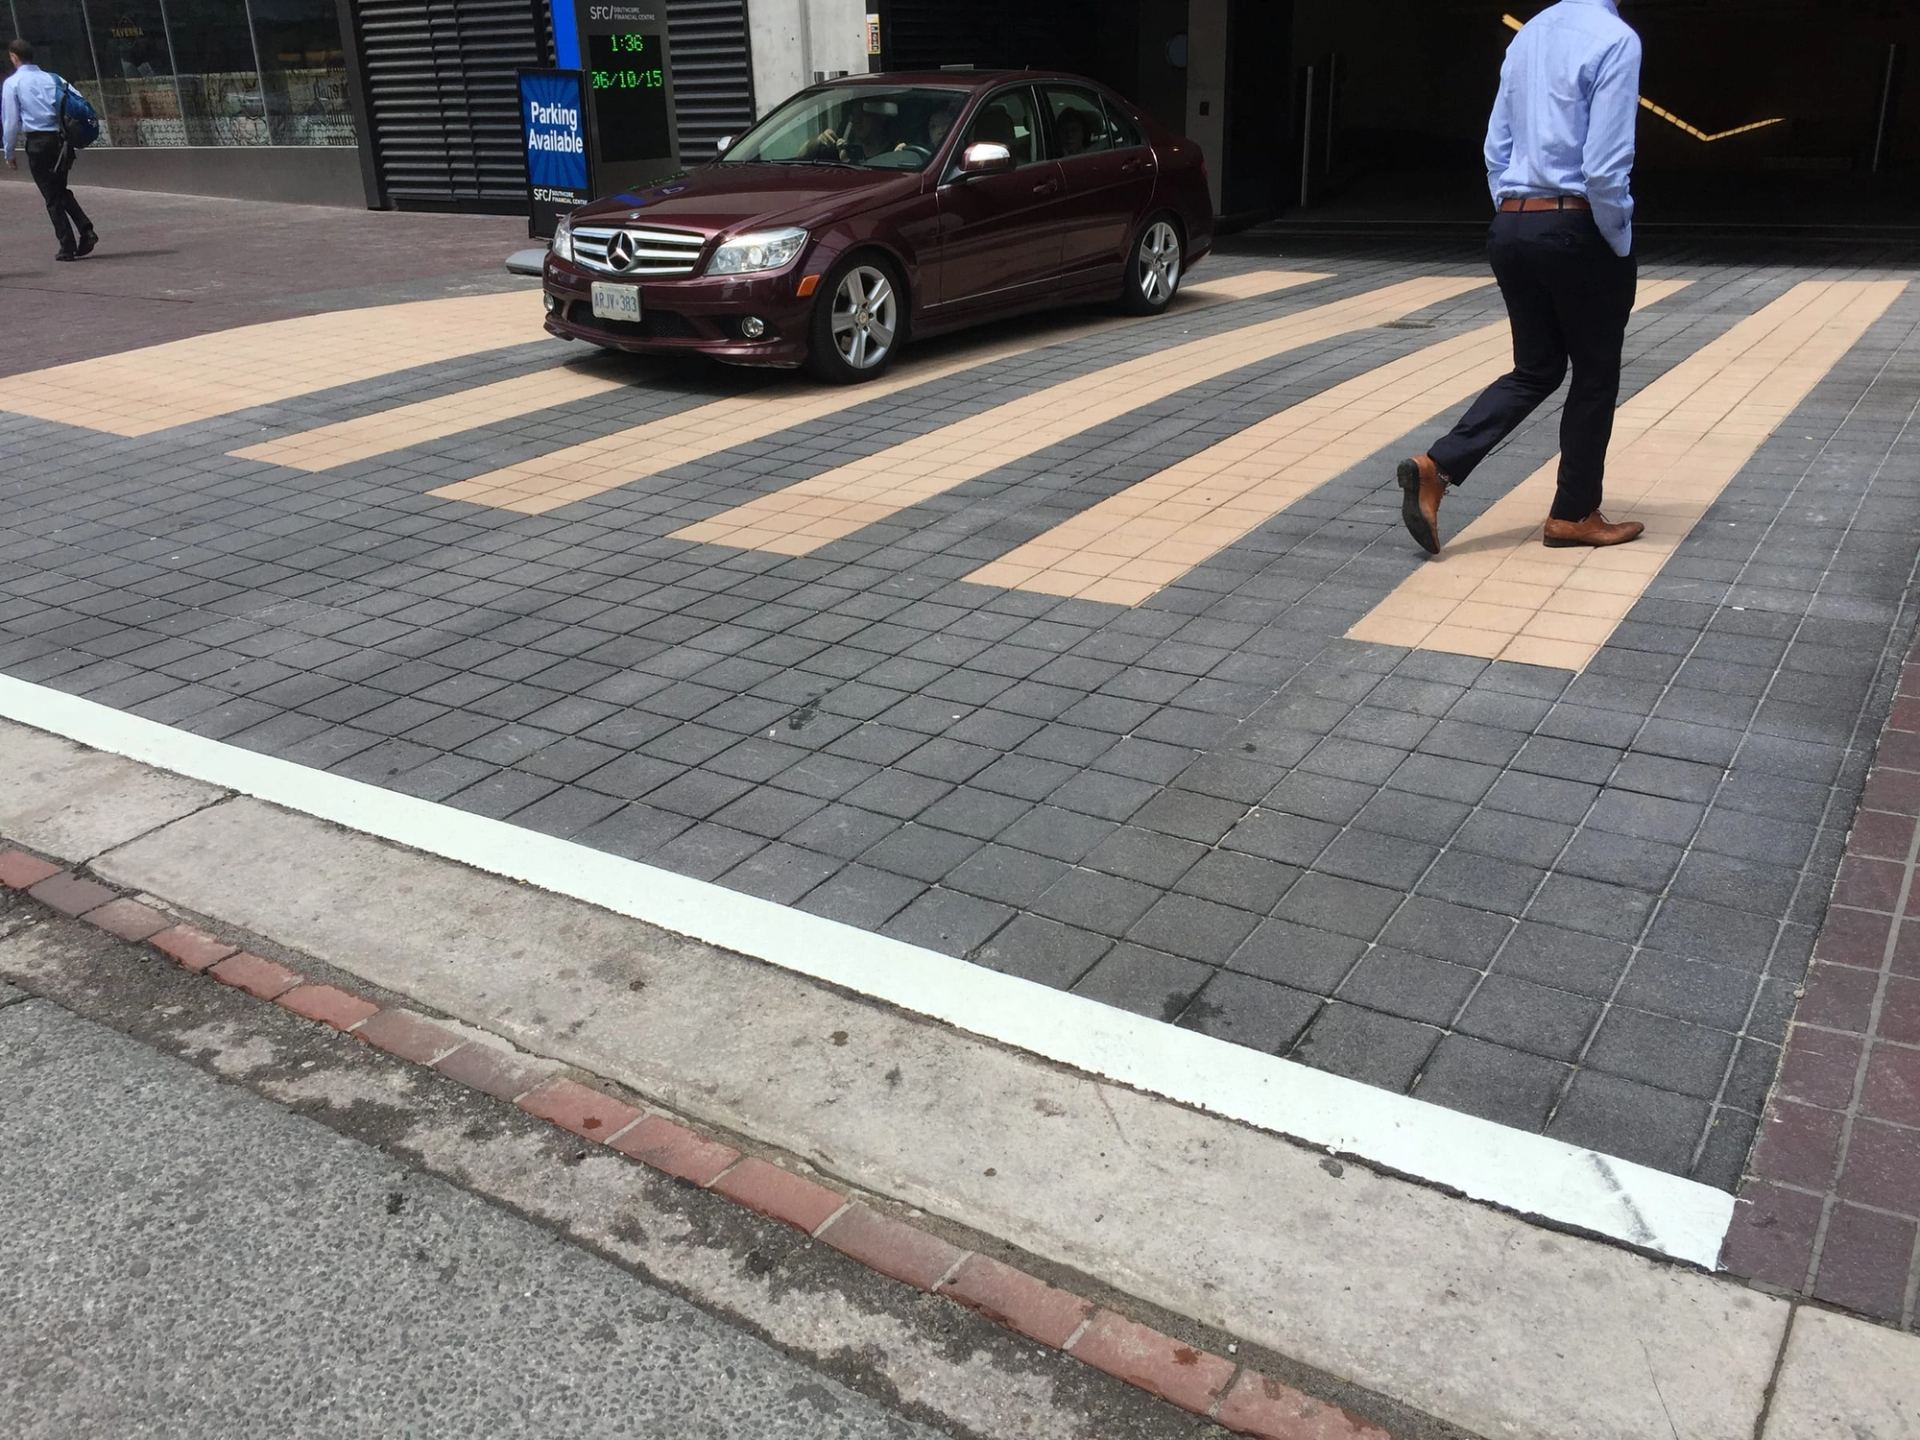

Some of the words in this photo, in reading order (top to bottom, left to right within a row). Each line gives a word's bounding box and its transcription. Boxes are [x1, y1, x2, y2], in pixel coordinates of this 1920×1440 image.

[611, 34, 643, 52] 1:36
[530, 101, 578, 132] Parking
[528, 128, 584, 154] Available
